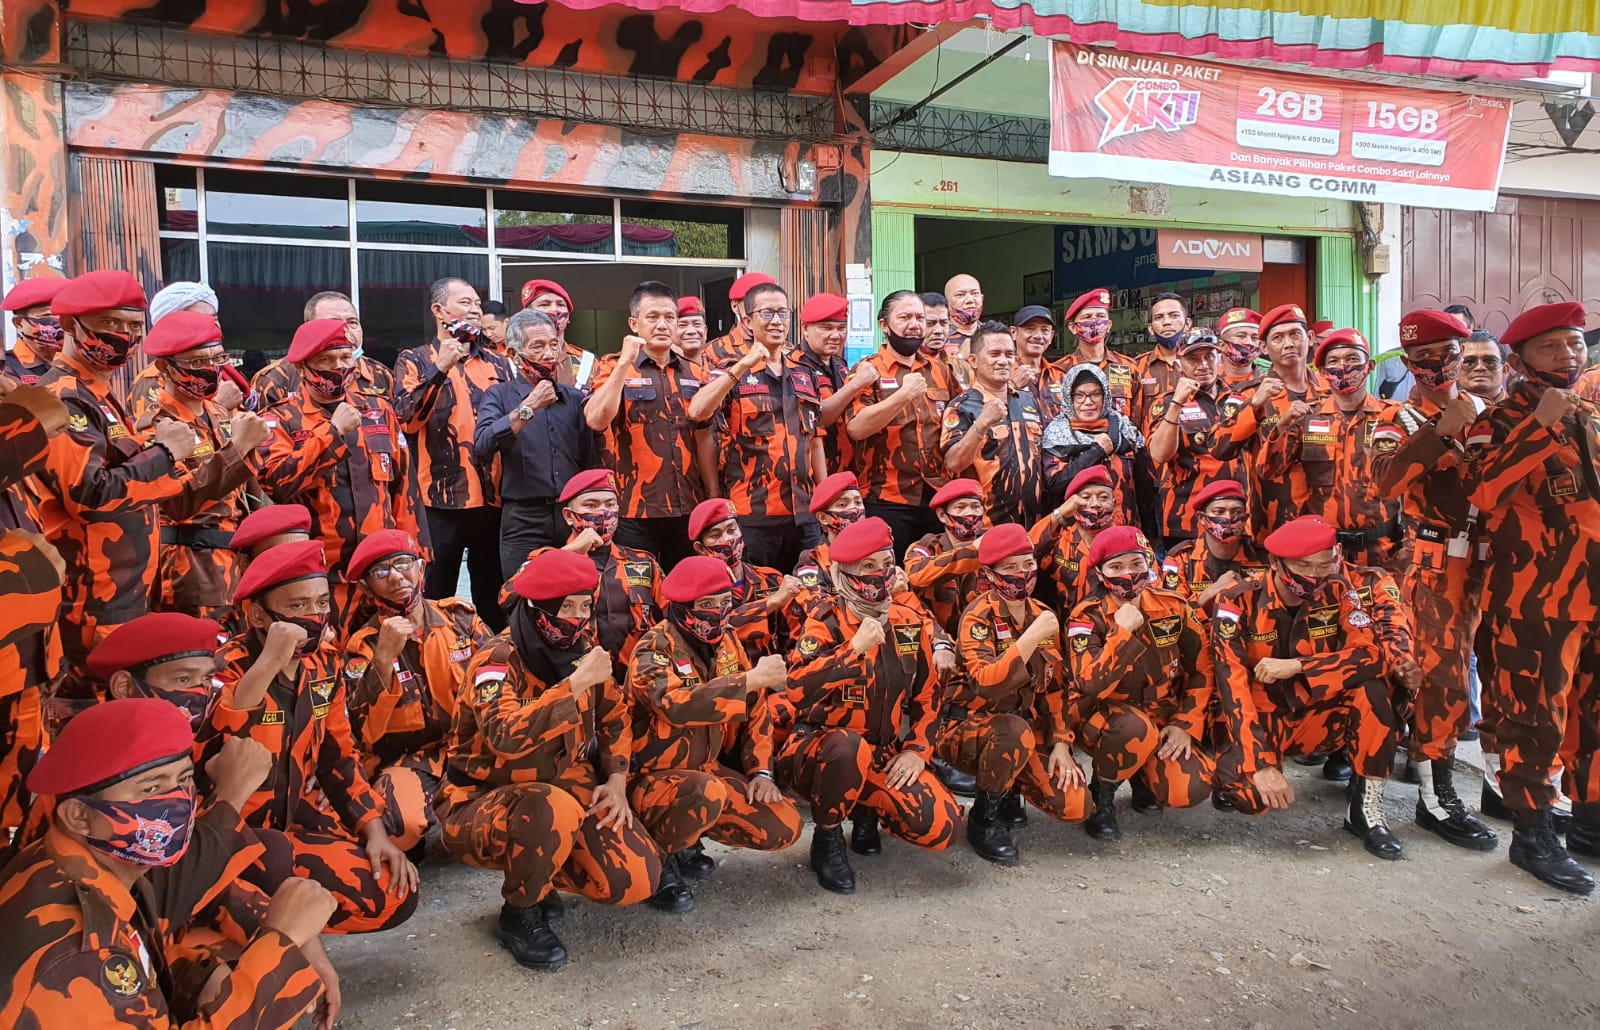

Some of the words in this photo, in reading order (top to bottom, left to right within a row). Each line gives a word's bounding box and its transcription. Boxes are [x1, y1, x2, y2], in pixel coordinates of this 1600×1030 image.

[1076, 50, 1094, 65] DI
[1096, 53, 1130, 71] SINI
[1131, 59, 1170, 76] JUAL
[1172, 64, 1222, 81] PAKET
[1136, 80, 1178, 91] COMBO
[1095, 78, 1200, 148] SAKTI
[1256, 86, 1323, 121] 2GB
[1367, 101, 1439, 134] 15GB
[1209, 167, 1301, 189] ASIANG
[1309, 177, 1377, 196] COMM
[1230, 152, 1251, 162] Dan
[1253, 154, 1292, 167] Banyak
[1293, 158, 1327, 170] Pilihan
[1328, 161, 1356, 172] Paket
[1357, 165, 1391, 176] Combo
[1391, 168, 1415, 179] Sakti
[1415, 171, 1451, 182] Lainnya
[940, 180, 958, 192] 261
[1171, 238, 1251, 260] ADVAN
